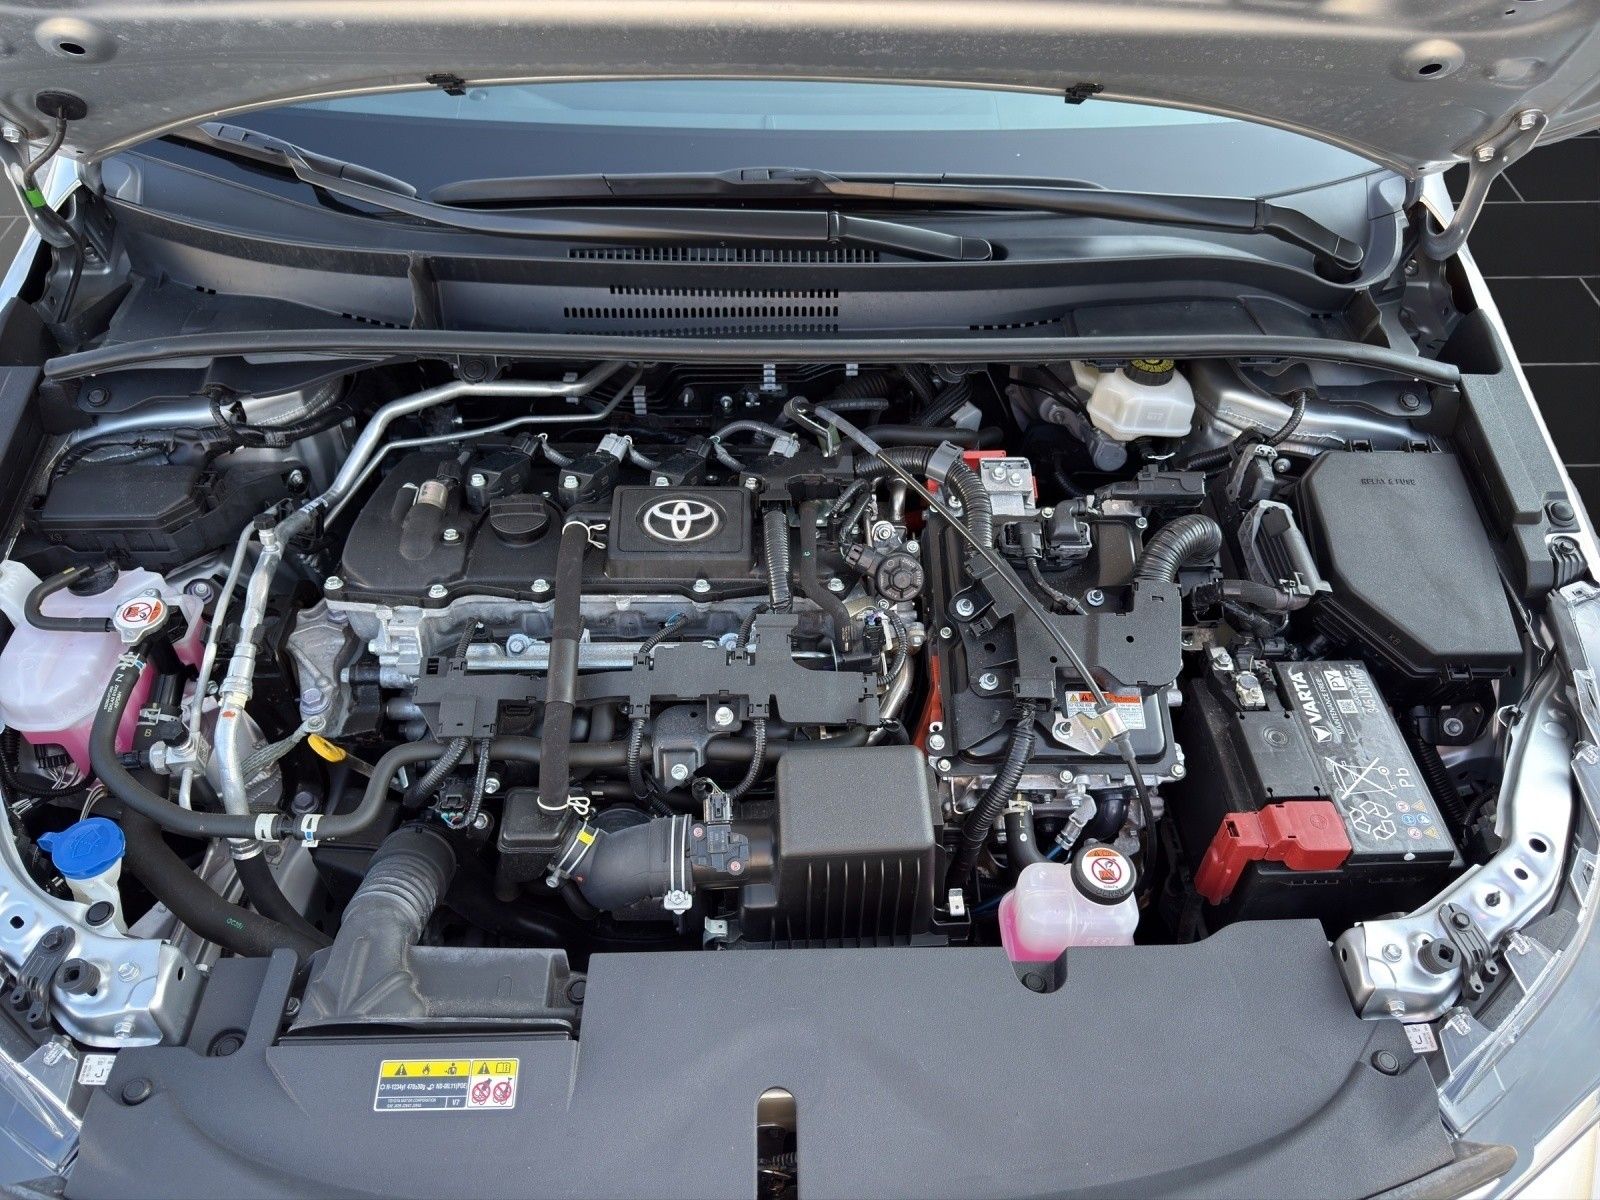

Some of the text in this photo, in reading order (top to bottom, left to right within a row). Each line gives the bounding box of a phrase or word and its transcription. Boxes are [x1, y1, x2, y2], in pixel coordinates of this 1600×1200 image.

[1395, 478, 1416, 486] FUSE
[1330, 672, 1345, 688] PY
[1289, 672, 1322, 724] VARTA
[1315, 678, 1345, 735] MAINTENANCE FREE
[1397, 767, 1416, 788] Pb
